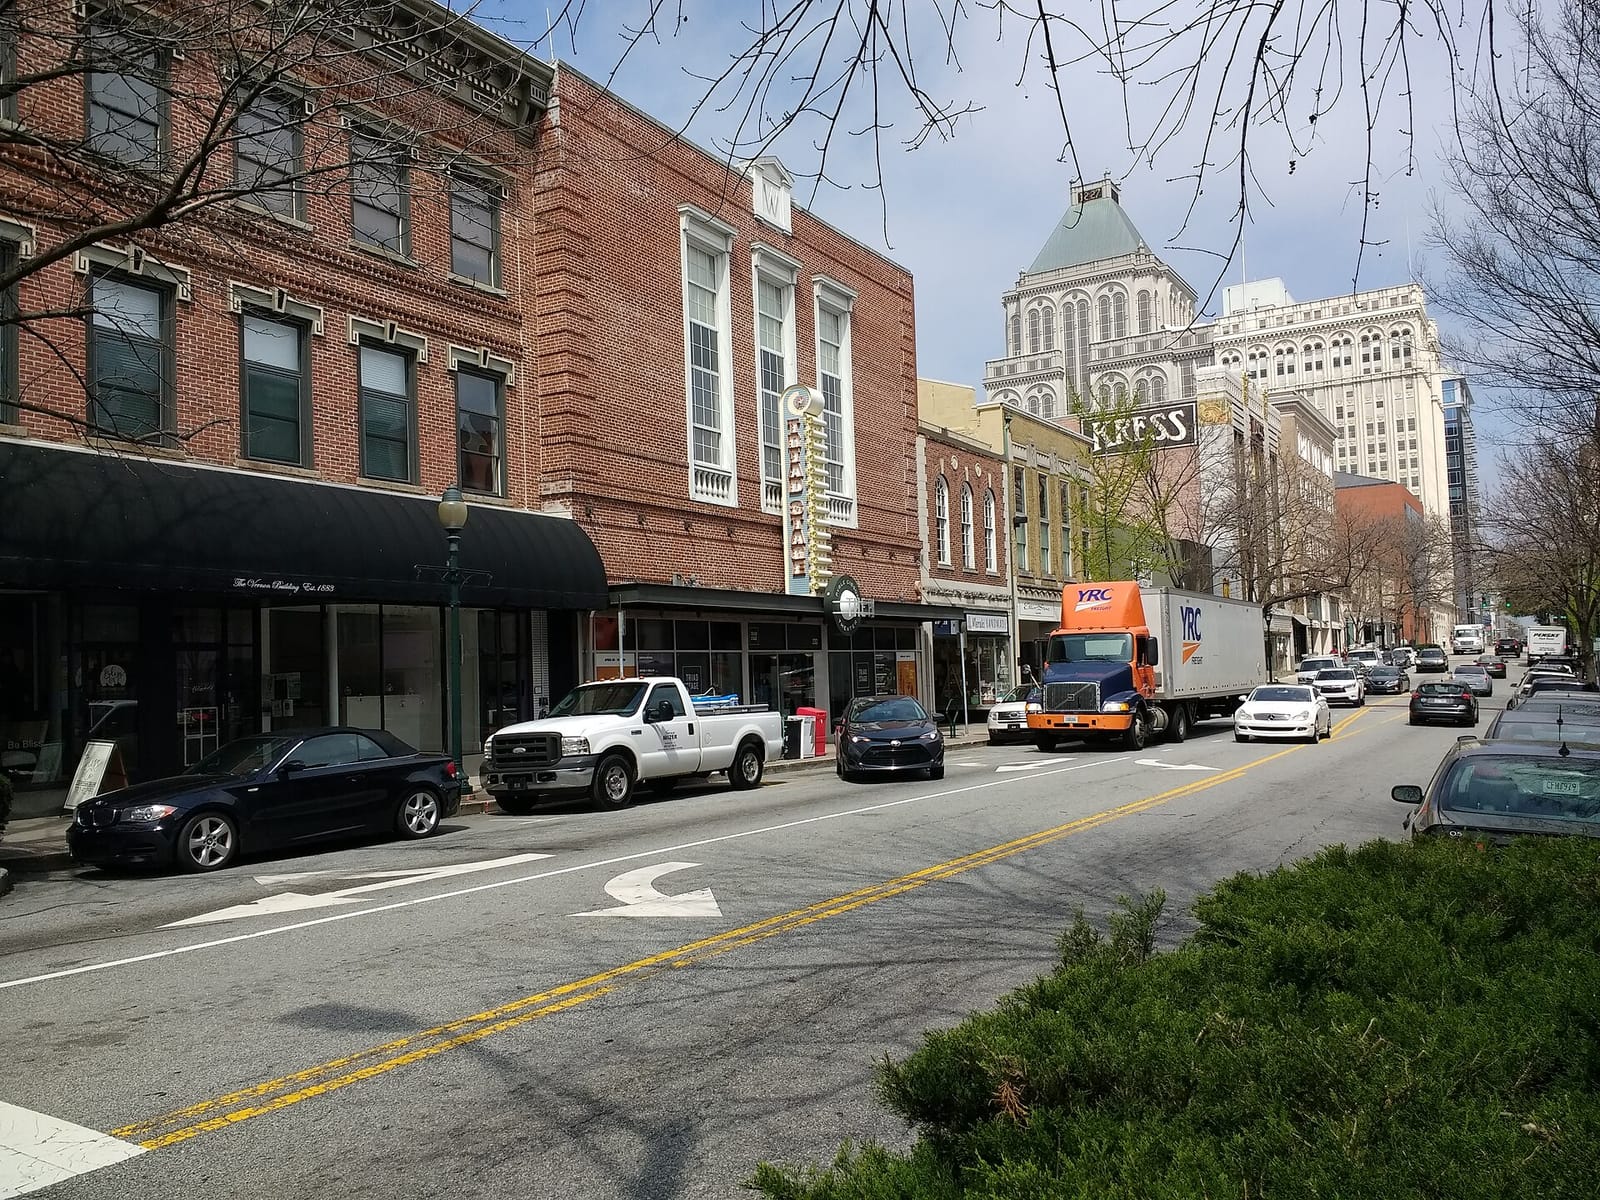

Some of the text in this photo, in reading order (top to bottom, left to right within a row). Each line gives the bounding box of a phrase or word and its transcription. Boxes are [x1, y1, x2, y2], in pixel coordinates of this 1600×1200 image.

[1092, 410, 1186, 452] KRESS
[233, 578, 246, 588] The
[1078, 588, 1113, 602] YRC
[1180, 605, 1202, 641] YRC
